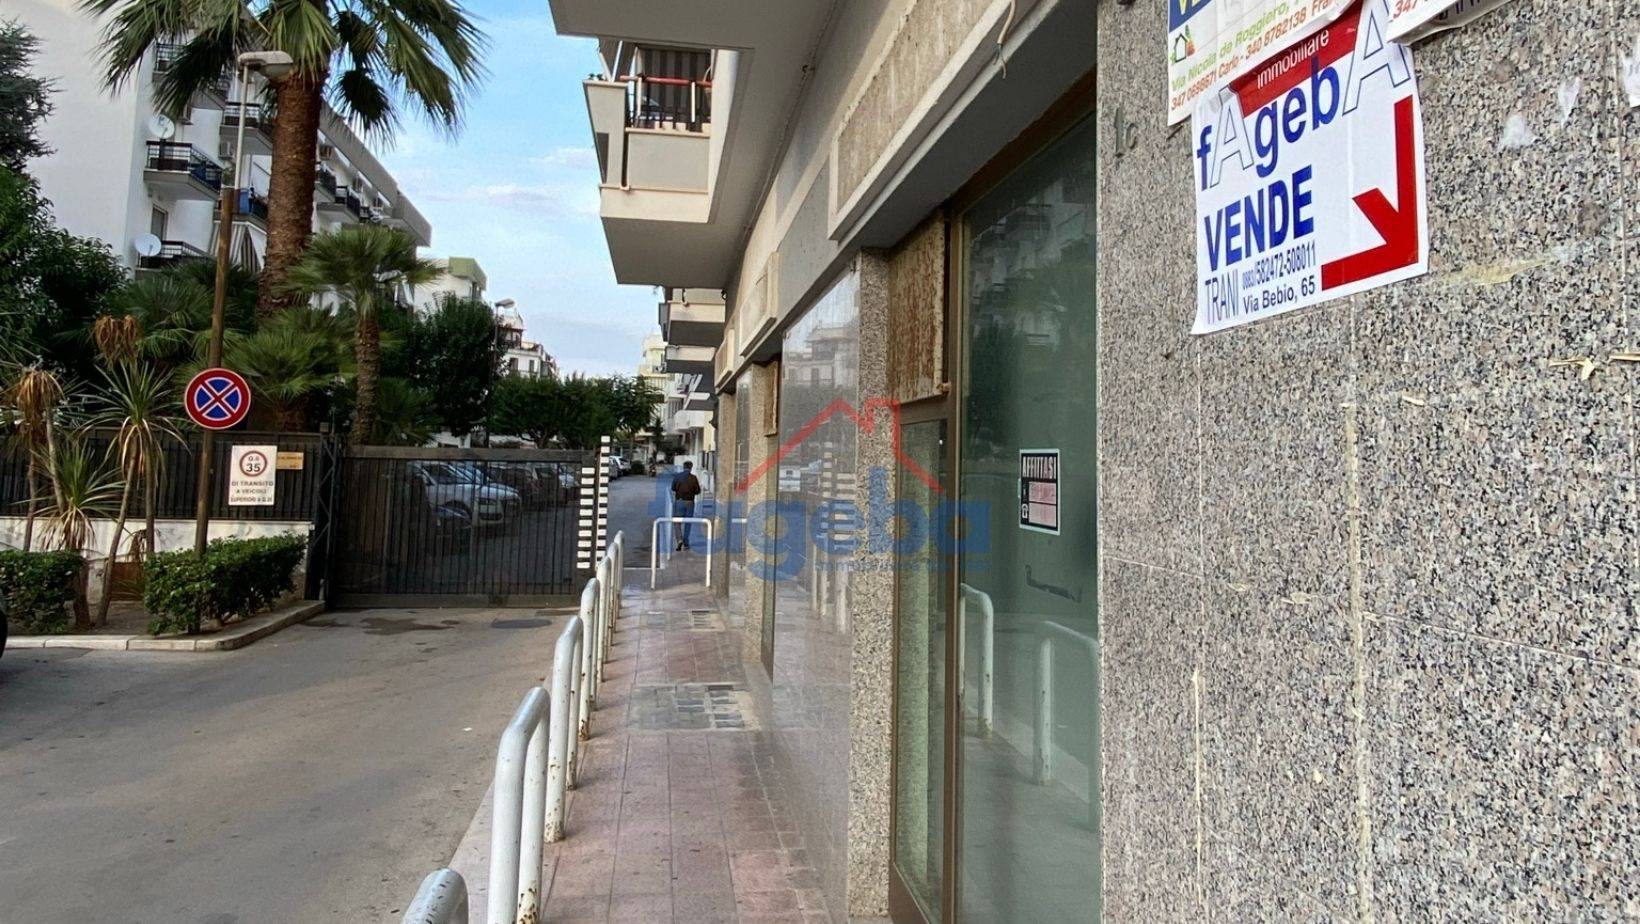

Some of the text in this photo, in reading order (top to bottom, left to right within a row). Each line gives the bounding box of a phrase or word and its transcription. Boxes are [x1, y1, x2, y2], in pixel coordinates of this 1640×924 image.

[1257, 29, 1329, 90] immobiliare
[1204, 164, 1314, 272] VENDE
[1205, 269, 1239, 324] TRANI
[1243, 275, 1316, 315] Via Bebio, 65
[246, 463, 261, 473] 35
[1022, 456, 1056, 480] AFFITTASI
